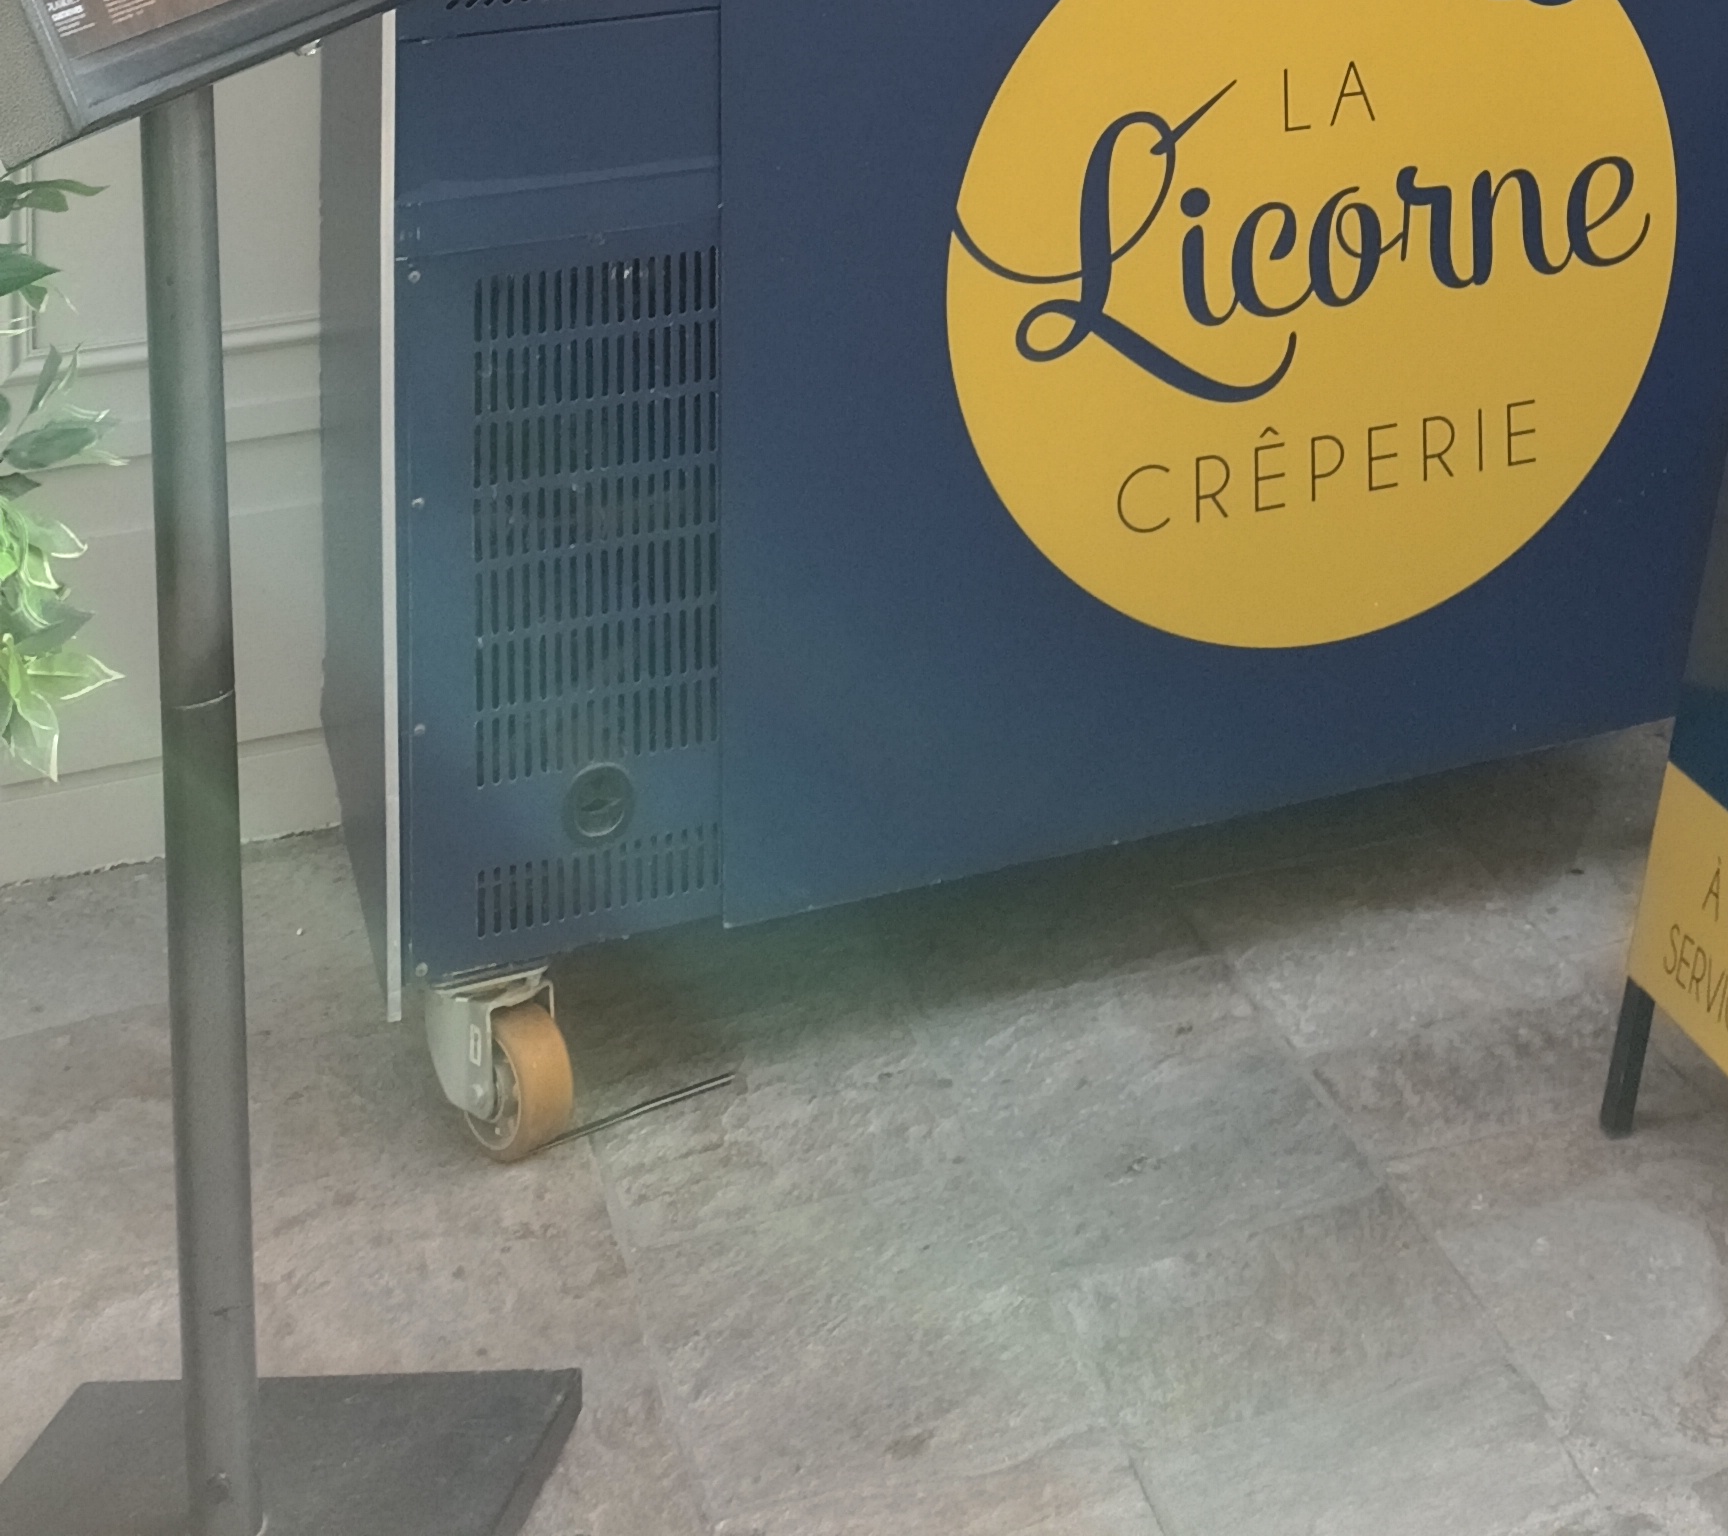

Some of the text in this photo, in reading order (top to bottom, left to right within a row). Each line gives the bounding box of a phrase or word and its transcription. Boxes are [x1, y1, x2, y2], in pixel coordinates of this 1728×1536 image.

[1283, 60, 1375, 132] LA
[951, 79, 1650, 404] Licorne
[1116, 399, 1537, 533] CRÊPERIE
[1702, 855, 1722, 923] À
